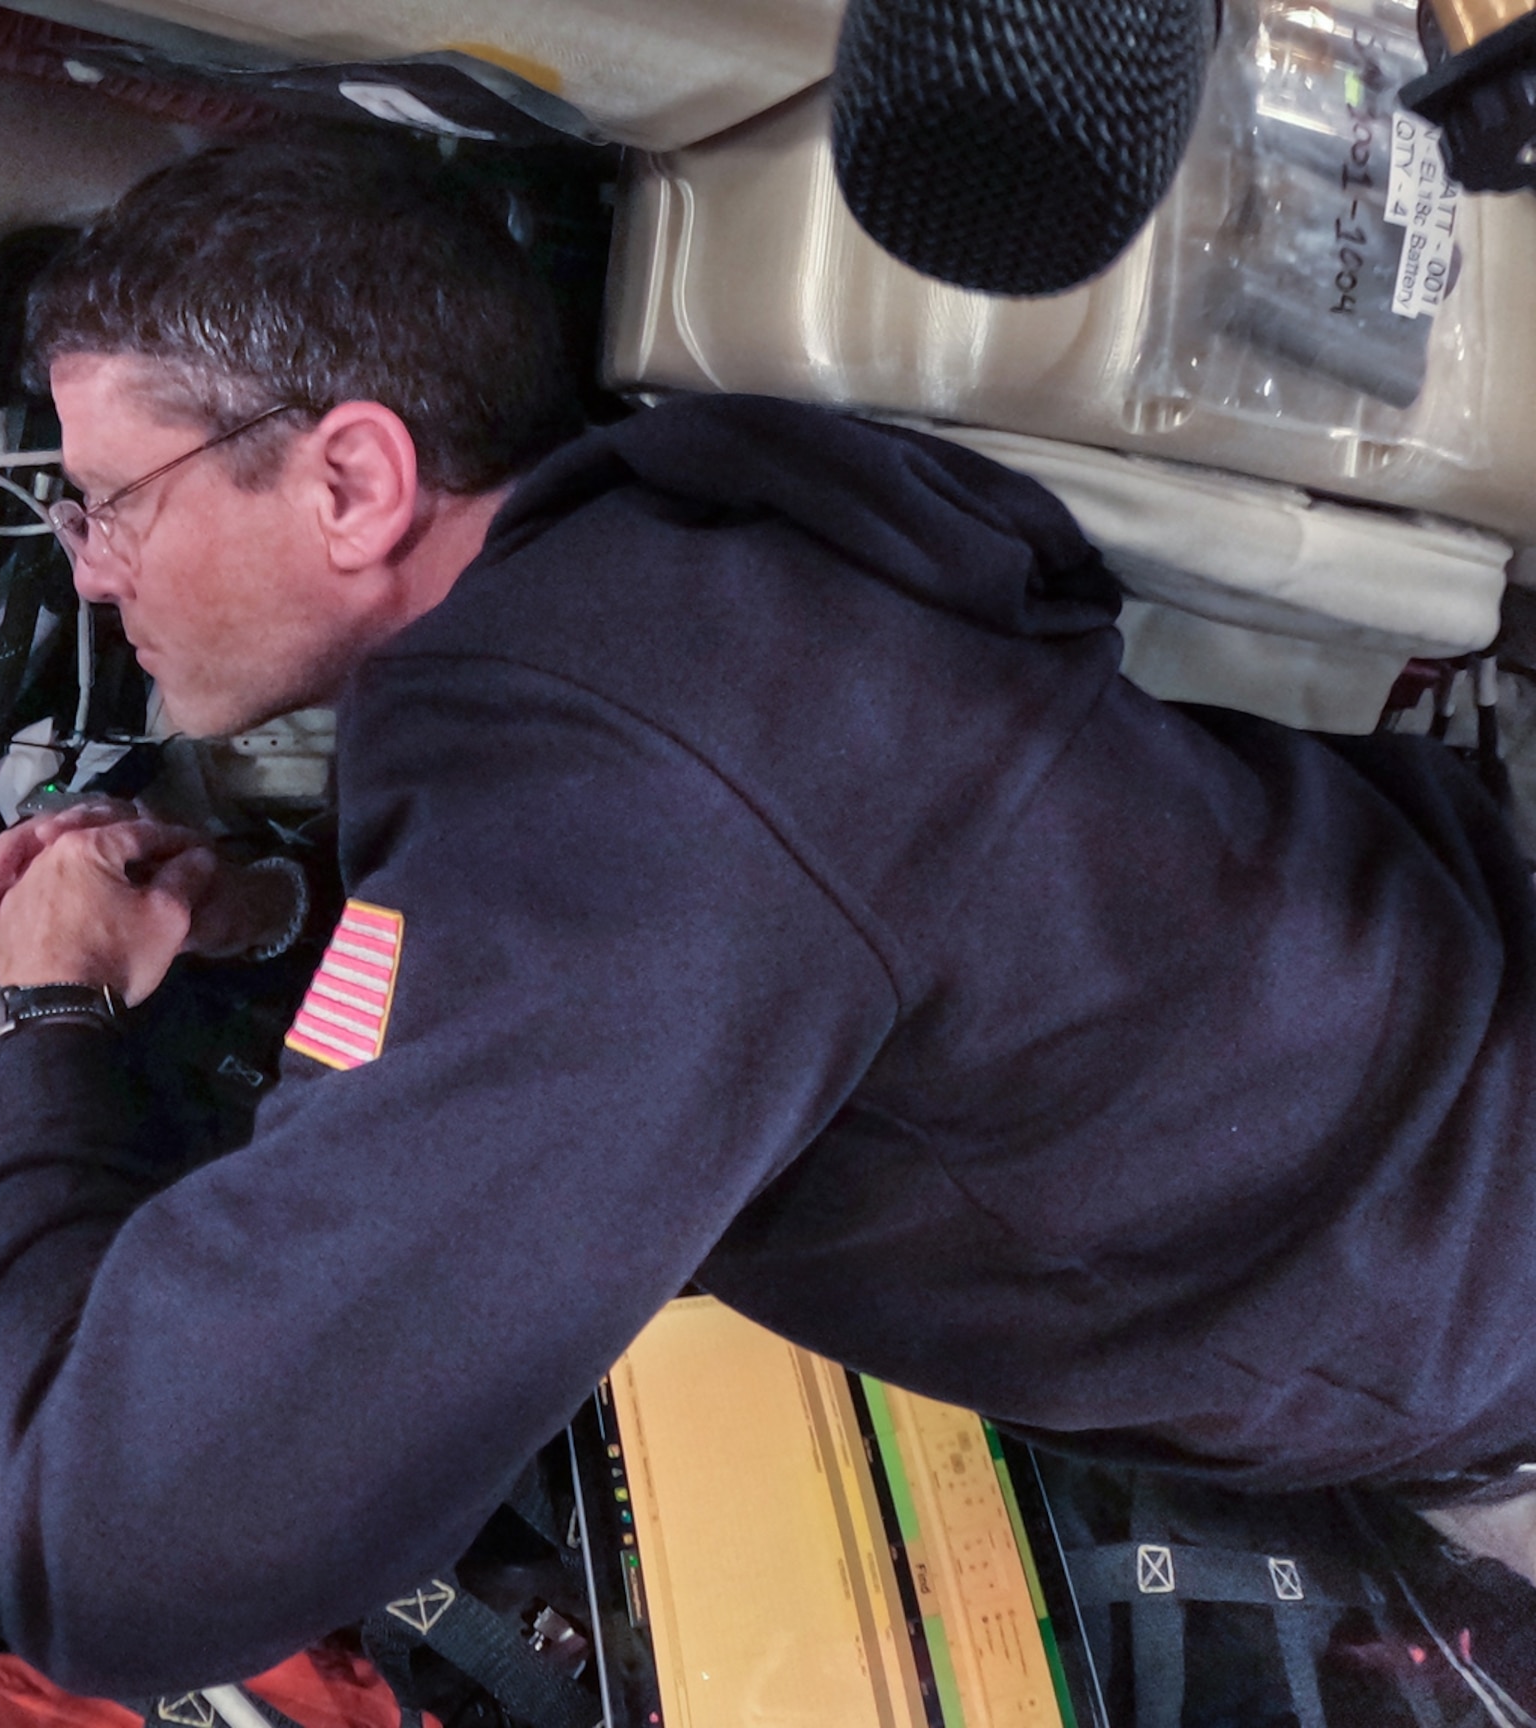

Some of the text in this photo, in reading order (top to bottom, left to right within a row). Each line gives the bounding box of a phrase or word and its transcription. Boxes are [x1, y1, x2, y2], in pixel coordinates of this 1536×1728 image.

[1394, 119, 1416, 180] QTY
[1392, 200, 1409, 218] 4
[1438, 180, 1458, 238] ATT
[1396, 233, 1428, 310] Battery
[1421, 258, 1447, 307] 001
[916, 1564, 931, 1594] Find
